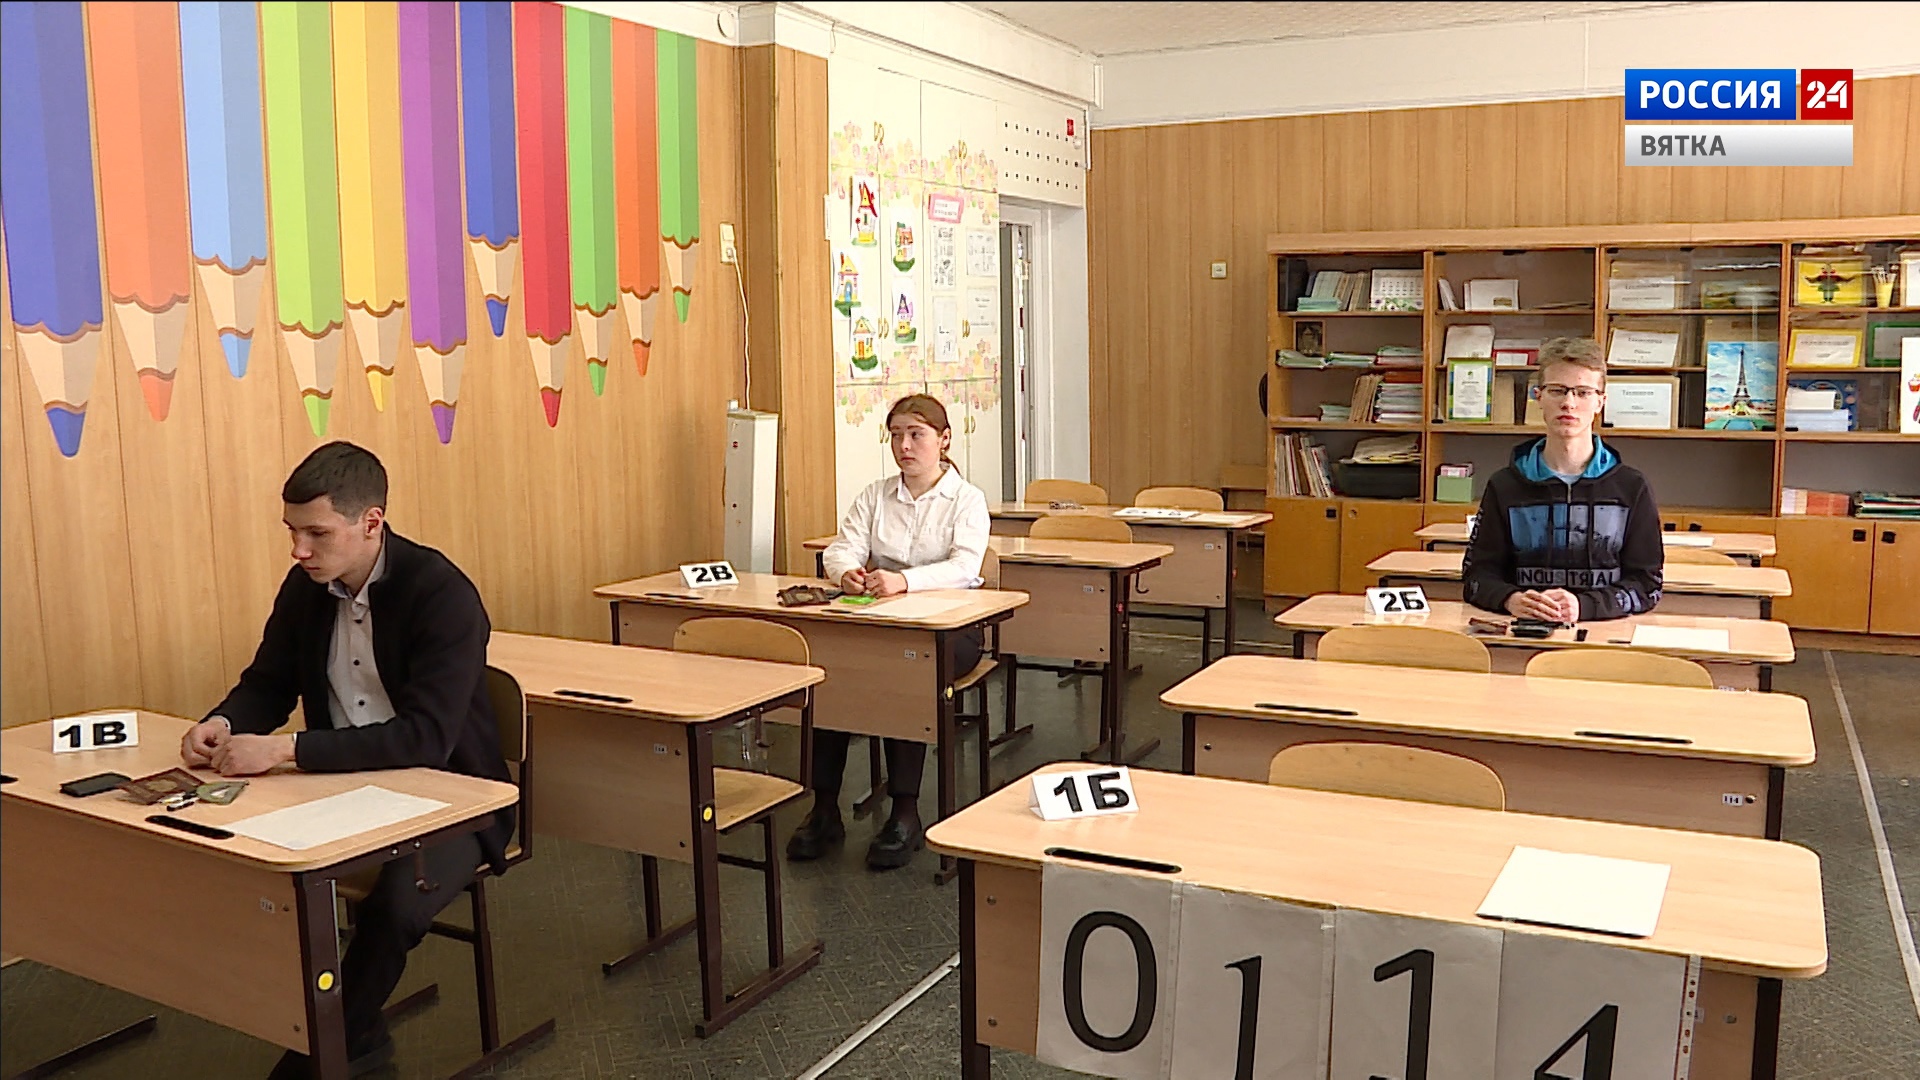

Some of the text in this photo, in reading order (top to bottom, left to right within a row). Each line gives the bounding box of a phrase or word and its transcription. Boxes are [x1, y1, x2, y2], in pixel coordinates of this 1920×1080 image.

[691, 565, 733, 583] 2В
[1379, 591, 1425, 612] 2Б
[58, 721, 127, 748] 1В
[1053, 771, 1130, 813] 1Б
